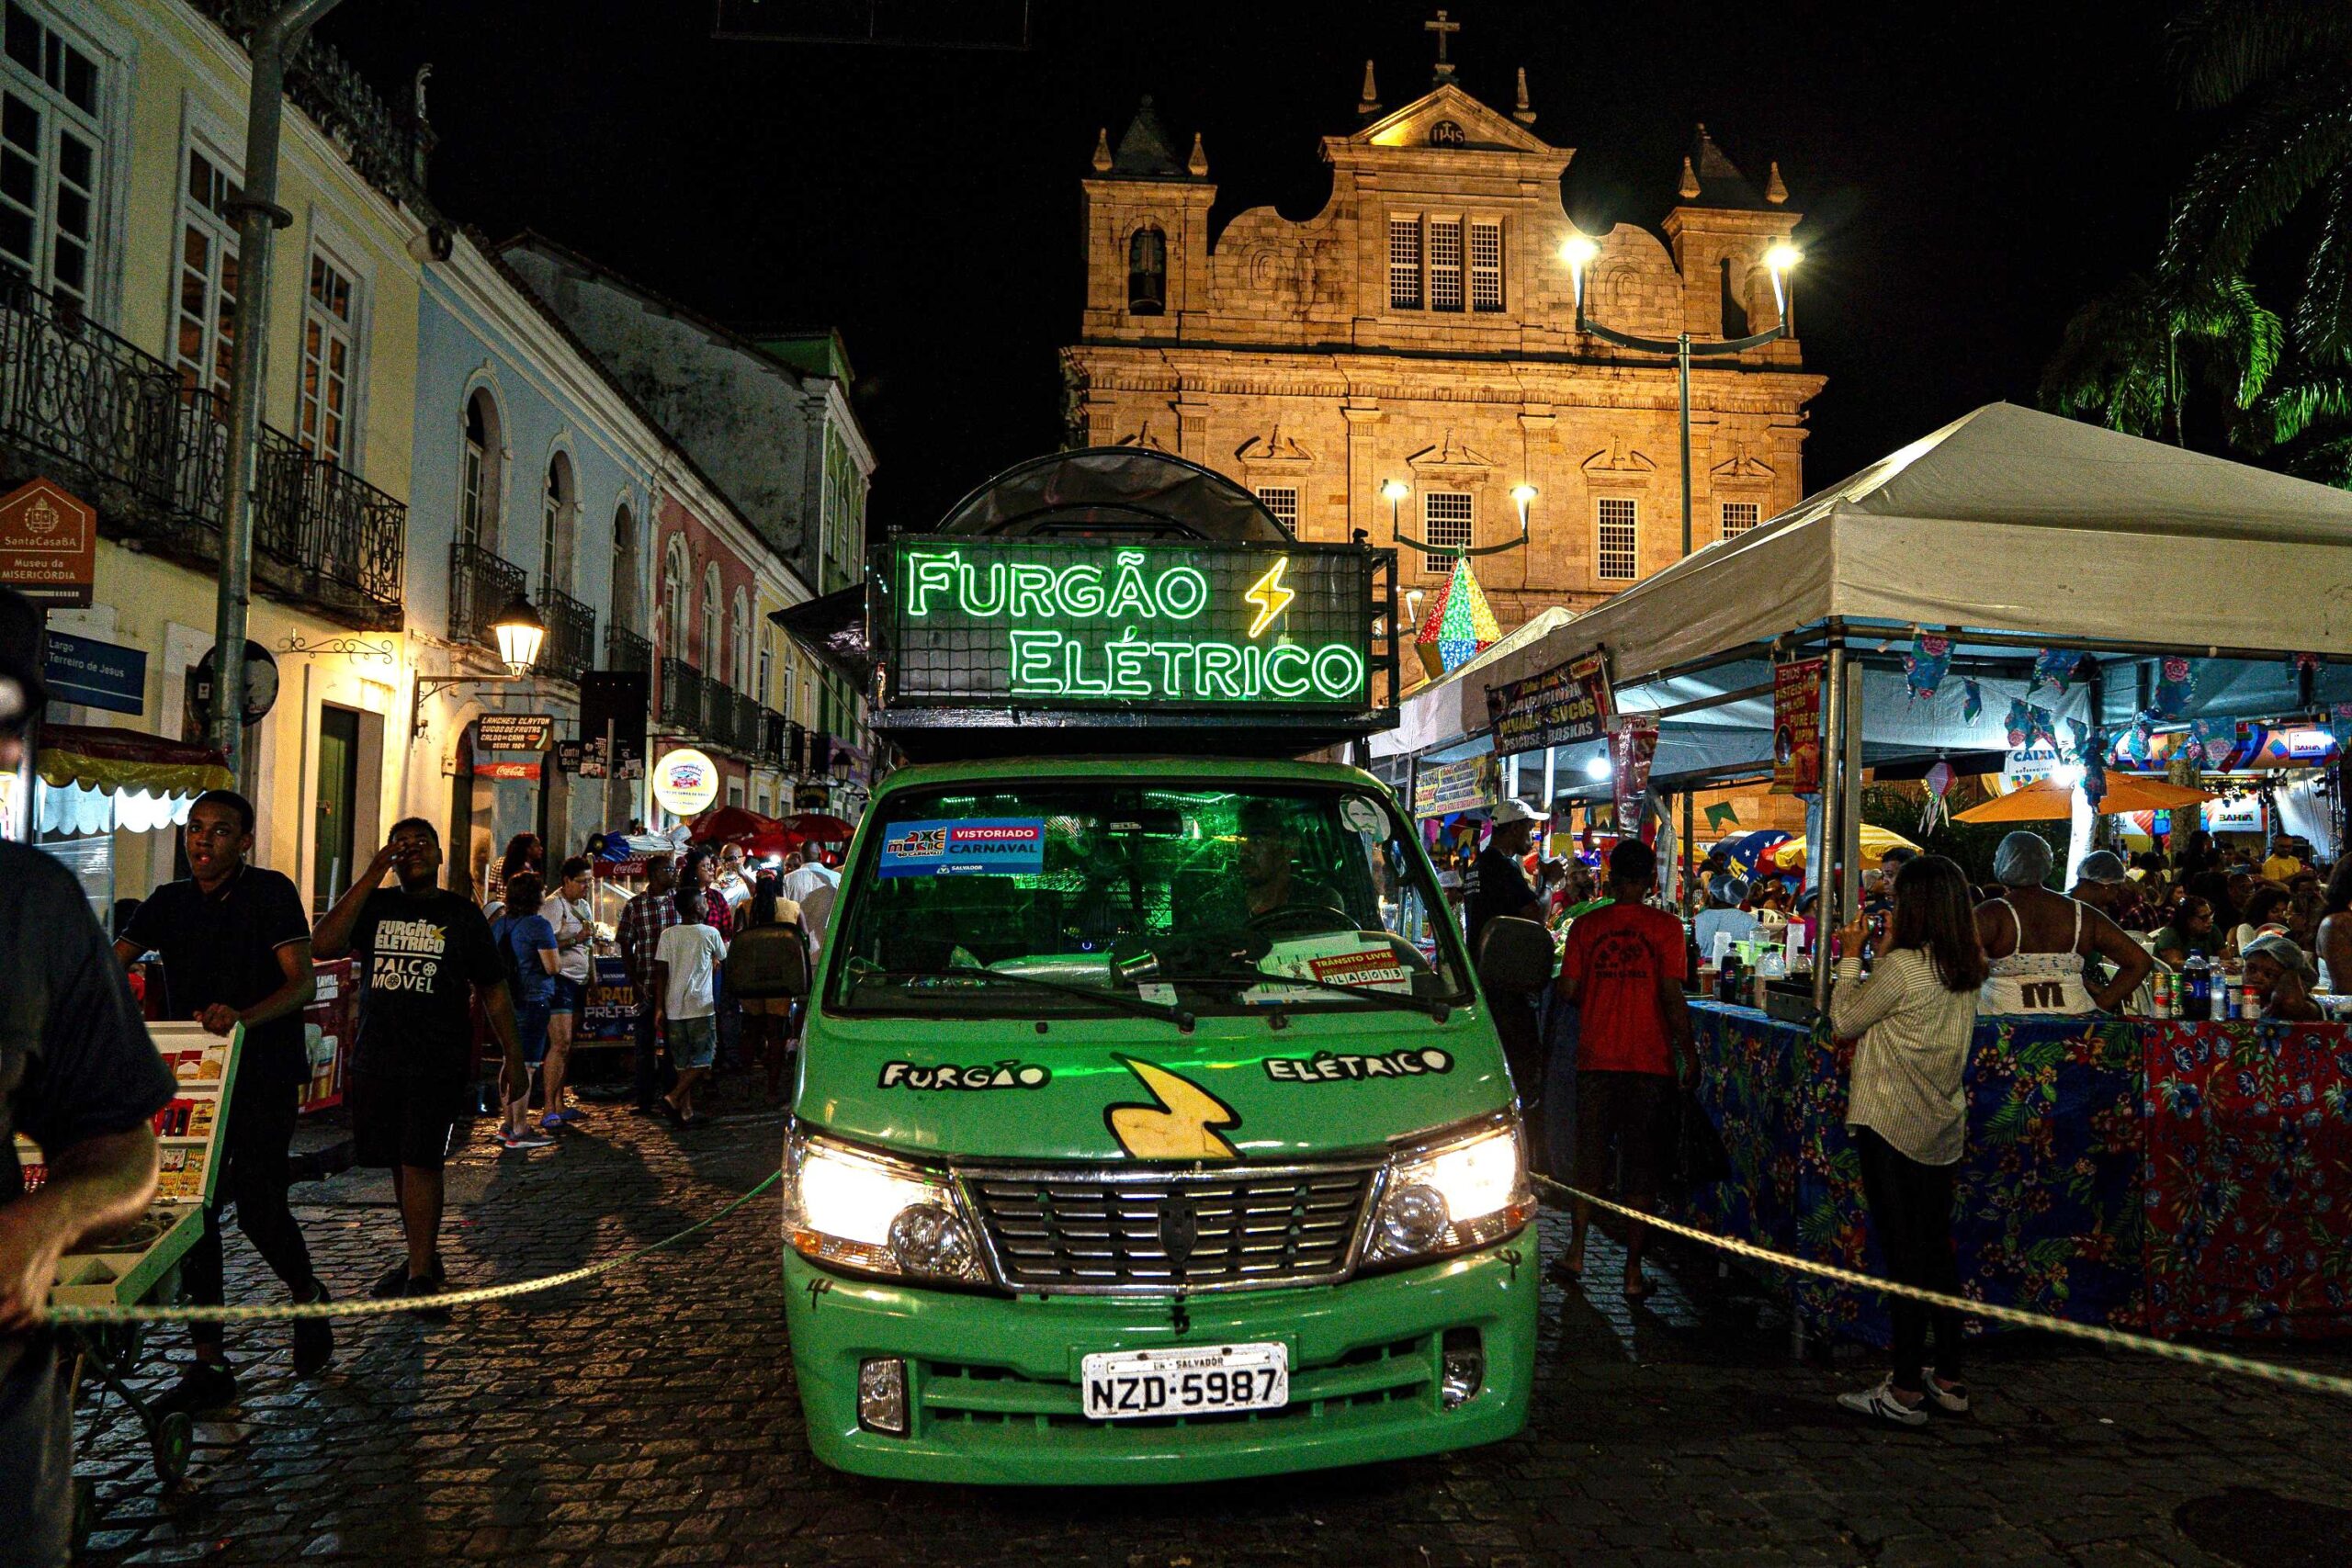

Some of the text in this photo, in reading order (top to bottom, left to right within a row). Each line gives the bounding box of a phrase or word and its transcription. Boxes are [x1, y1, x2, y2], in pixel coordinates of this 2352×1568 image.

[5, 536, 76, 547] SantaCasaBA
[14, 558, 63, 568] Museu da
[908, 550, 1206, 619] FURGÃO
[49, 637, 74, 652] Largo
[49, 652, 125, 678] Terreiro de Jesus
[1009, 625, 1365, 699] ELÉTRICO
[481, 716, 516, 725] LANCHES
[2013, 750, 2055, 761] CAIXA
[496, 765, 526, 777] Coca-Cola
[956, 829, 1035, 839] VISTORIADO
[949, 843, 1037, 854] CARNAVAL
[613, 863, 643, 874] Coca-Cola
[1316, 952, 1393, 967] TRÂNSITO LIVRE
[1262, 1047, 1454, 1082] ELÉTRICO
[878, 1059, 1053, 1090] FURGÃO
[1175, 1358, 1225, 1368] SALVADOR
